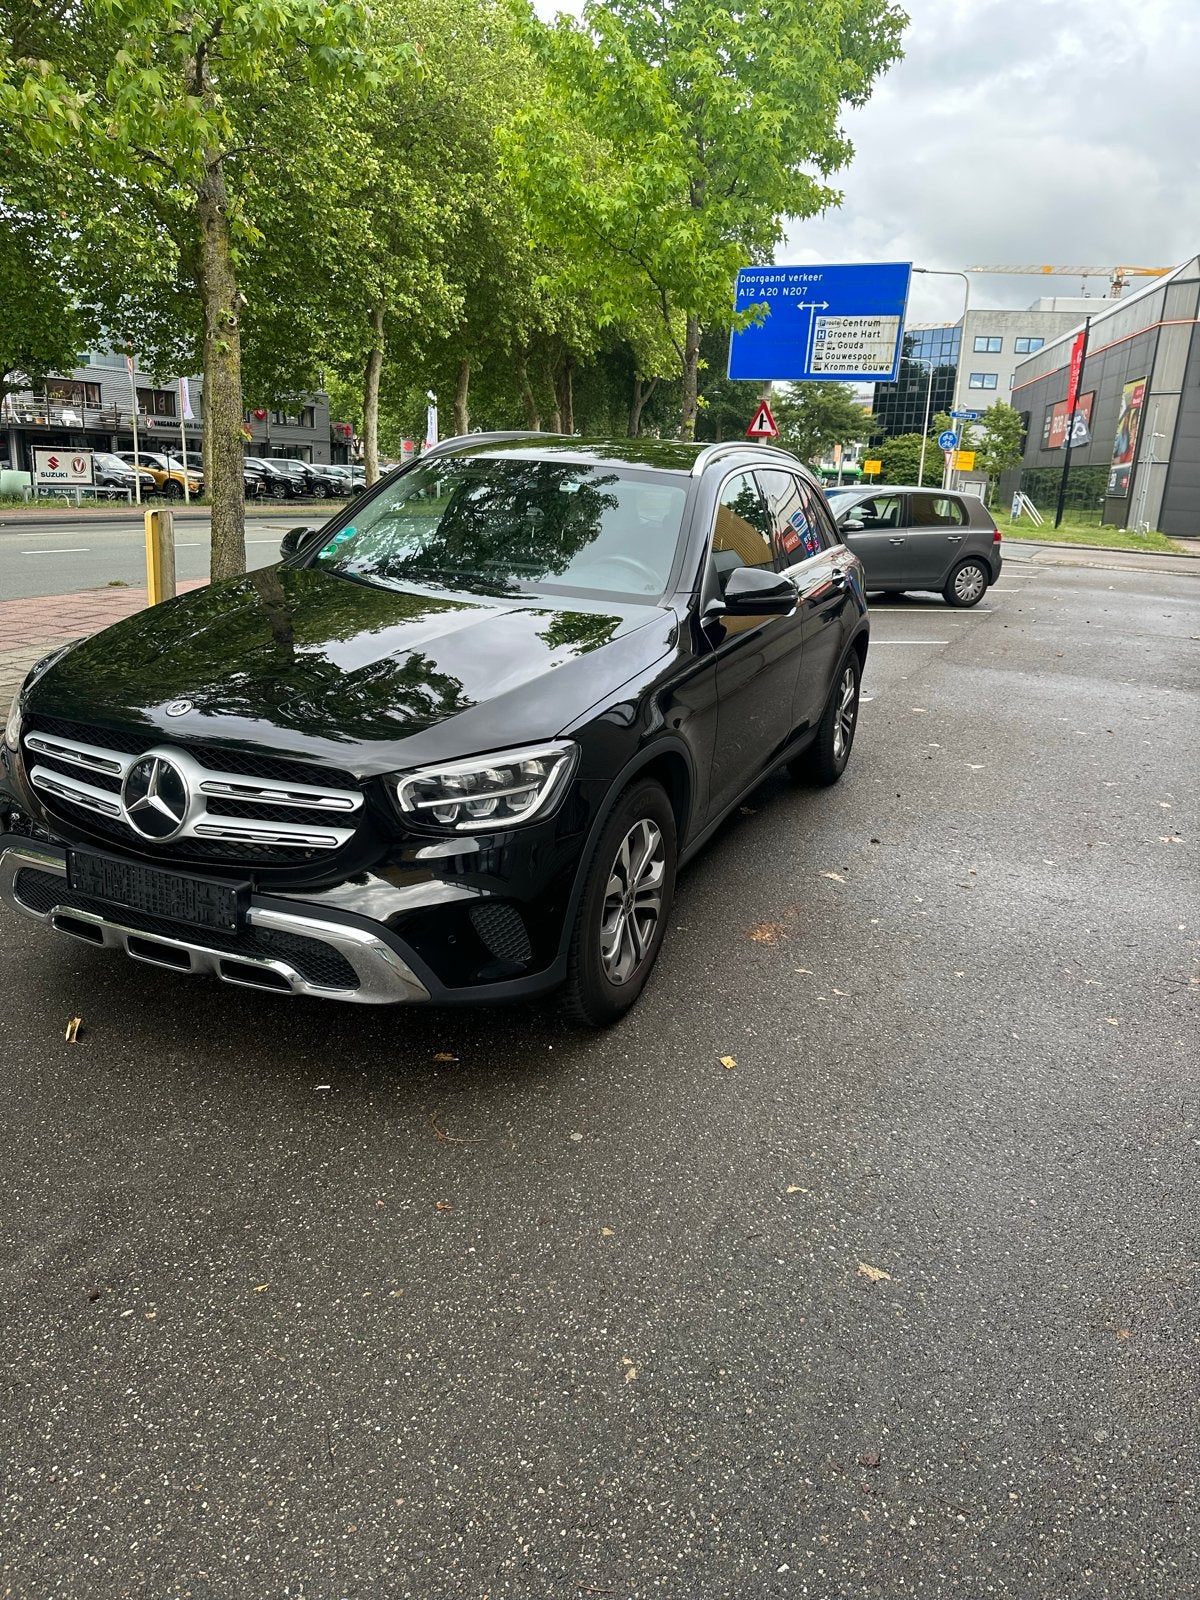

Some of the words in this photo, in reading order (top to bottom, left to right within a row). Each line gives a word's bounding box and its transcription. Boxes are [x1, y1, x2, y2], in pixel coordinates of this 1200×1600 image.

[740, 273, 786, 285] Doorgaand
[788, 272, 823, 282] verkeer
[738, 288, 755, 297] A12
[759, 287, 779, 297] A20
[782, 286, 808, 296] N207
[842, 318, 881, 327] Centrum
[827, 330, 858, 339] Groene
[860, 330, 881, 339] Hart
[837, 341, 864, 349] Gouda
[825, 352, 877, 361] Gouwespoor
[823, 362, 859, 371] Kromme
[861, 363, 890, 371] Gouwe
